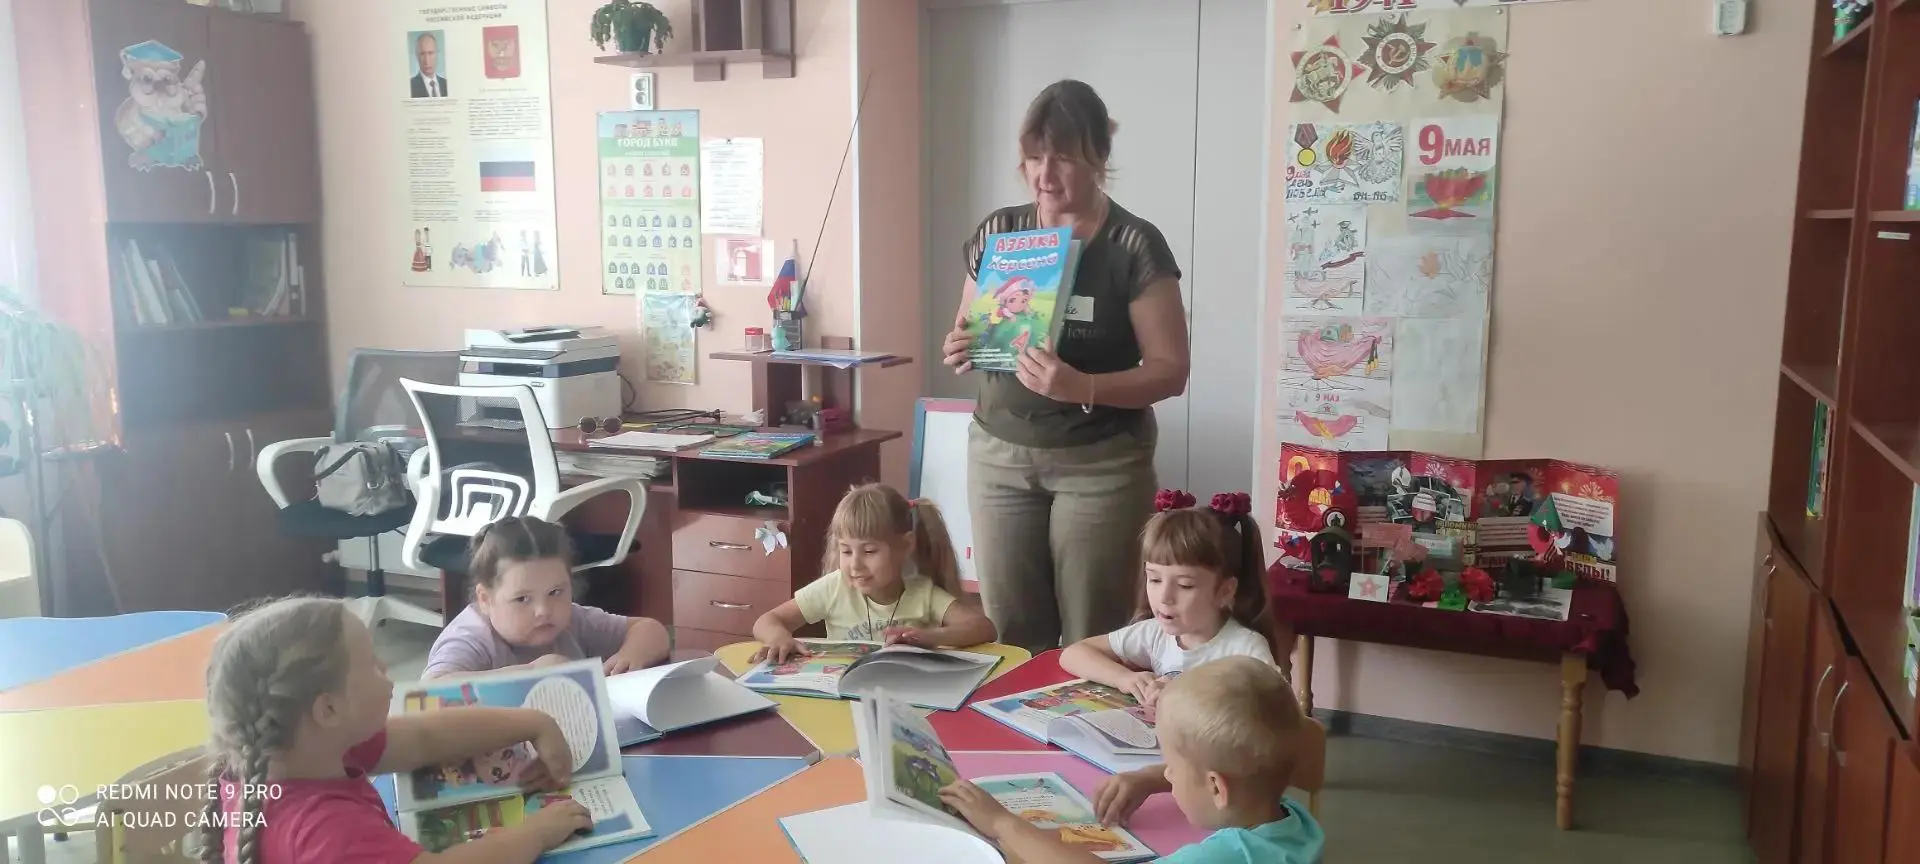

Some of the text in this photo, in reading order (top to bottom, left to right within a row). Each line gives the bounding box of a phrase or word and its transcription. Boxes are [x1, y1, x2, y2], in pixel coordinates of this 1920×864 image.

[617, 137, 650, 148] ГОРОД
[1419, 124, 1491, 165] 9 МАЯ
[996, 232, 1059, 252] АЗБУКА
